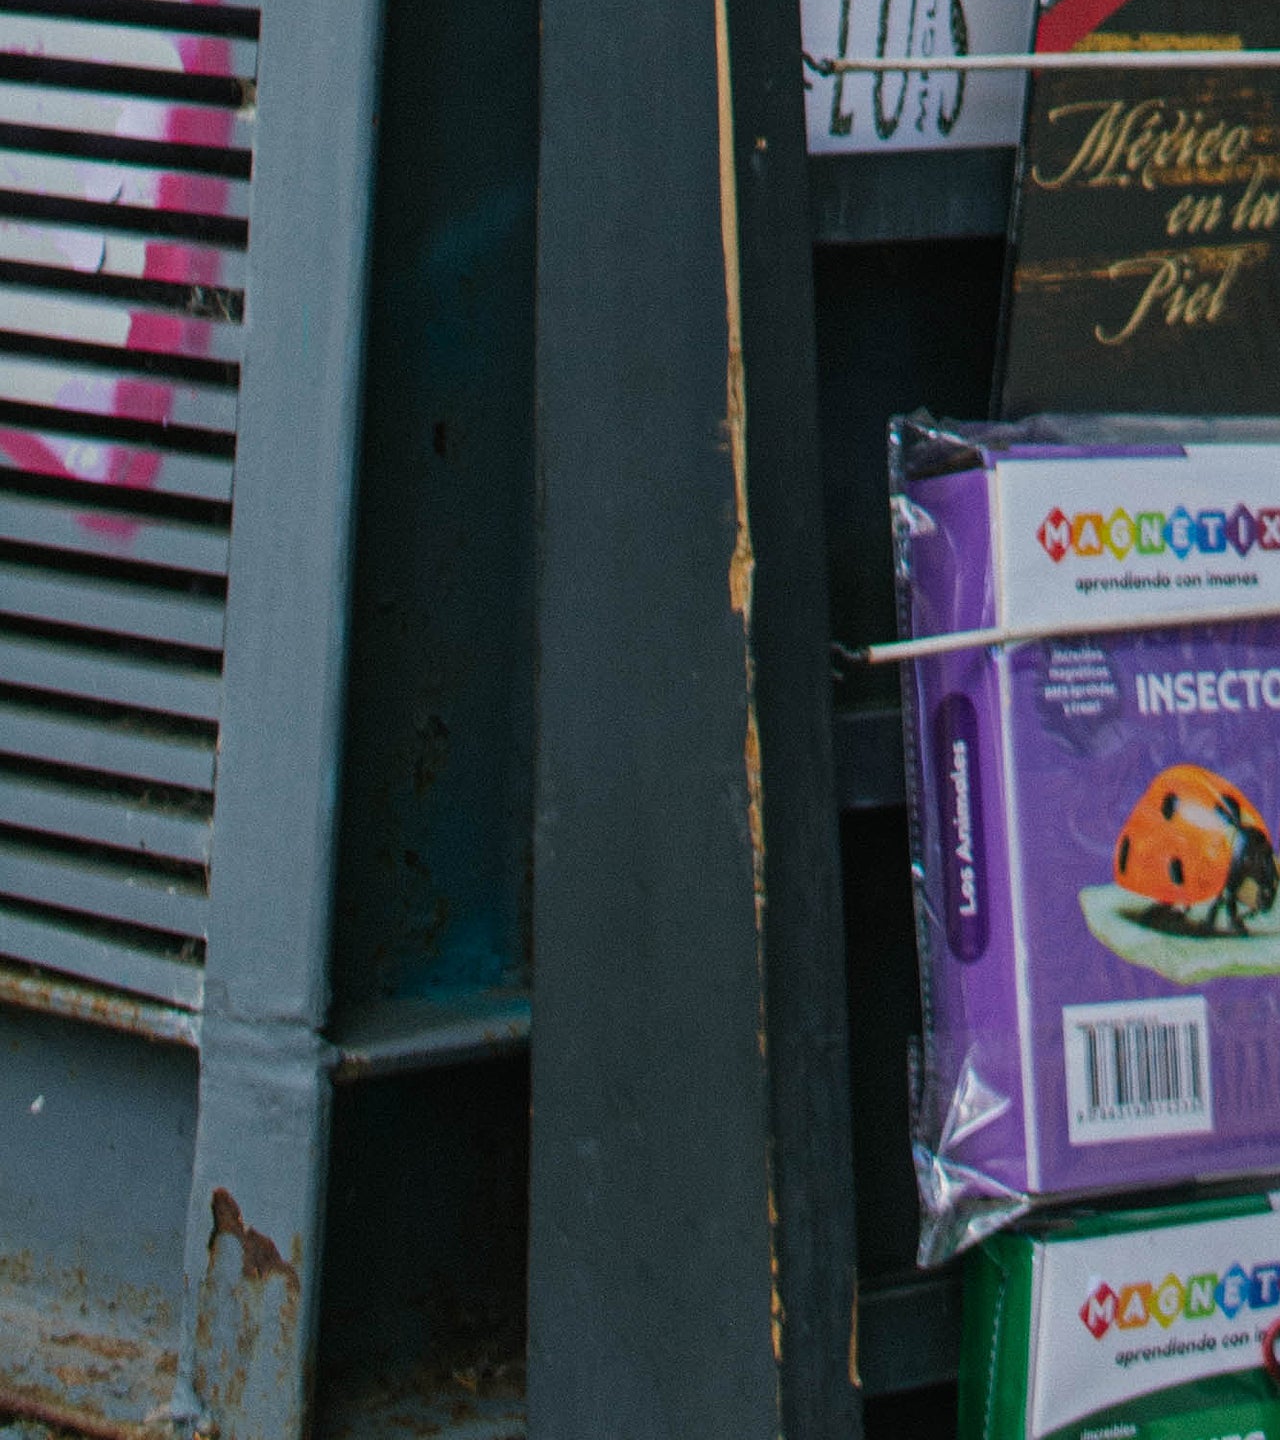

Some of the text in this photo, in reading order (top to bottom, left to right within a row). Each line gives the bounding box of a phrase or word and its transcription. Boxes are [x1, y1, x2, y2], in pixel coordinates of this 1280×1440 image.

[1032, 99, 1251, 191] México
[1167, 192, 1224, 235] en
[1095, 247, 1245, 346] Piel
